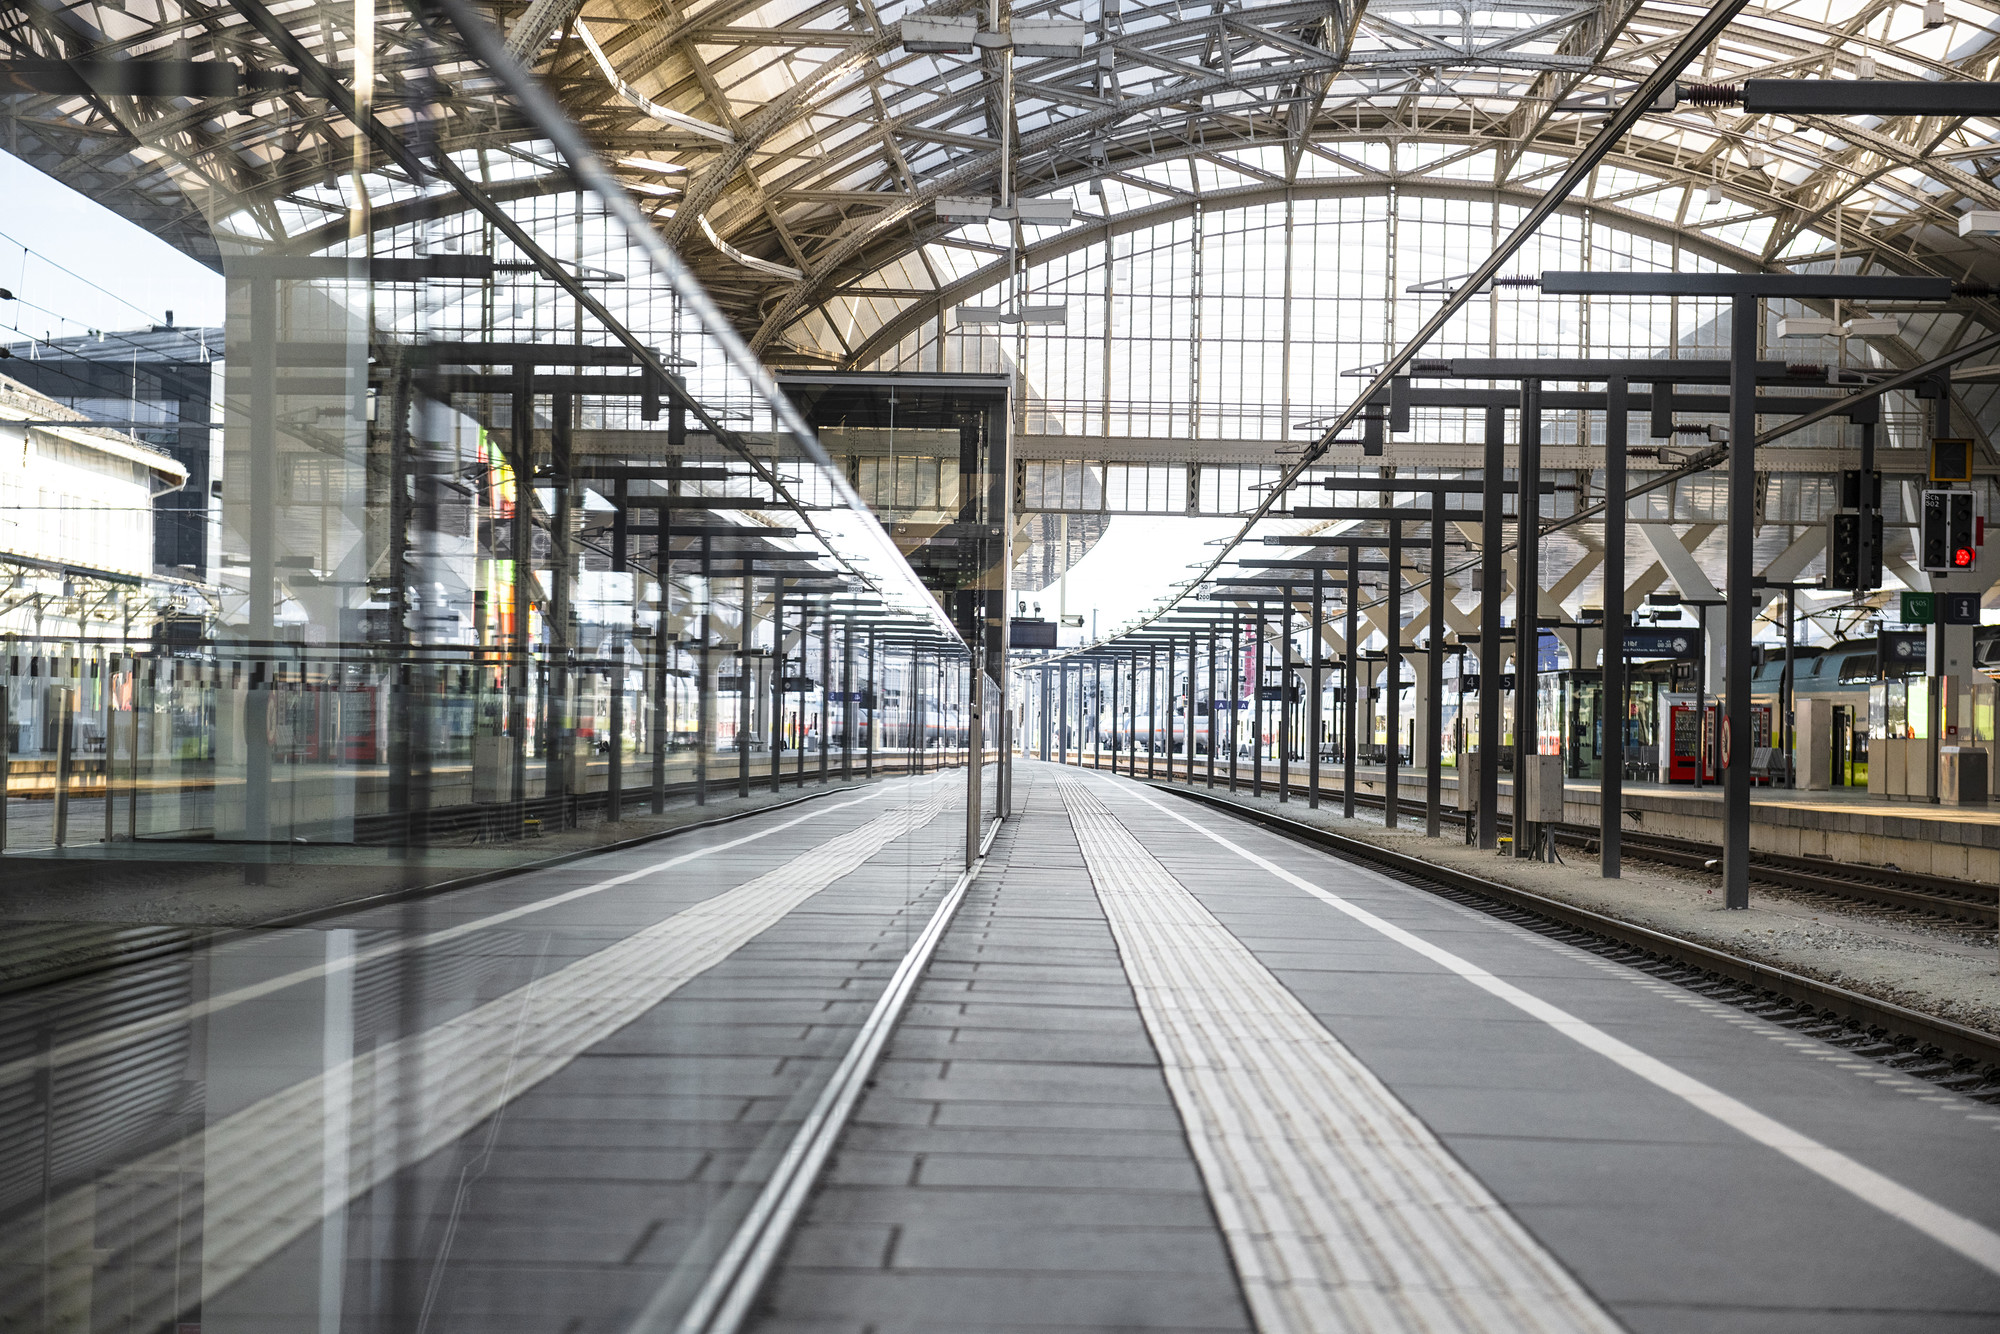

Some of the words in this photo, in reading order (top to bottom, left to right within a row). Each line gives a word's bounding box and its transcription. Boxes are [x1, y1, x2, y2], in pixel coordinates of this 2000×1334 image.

[1925, 493, 1939, 501] Sch
[1466, 677, 1475, 687] 4
[1503, 677, 1511, 688] 5
